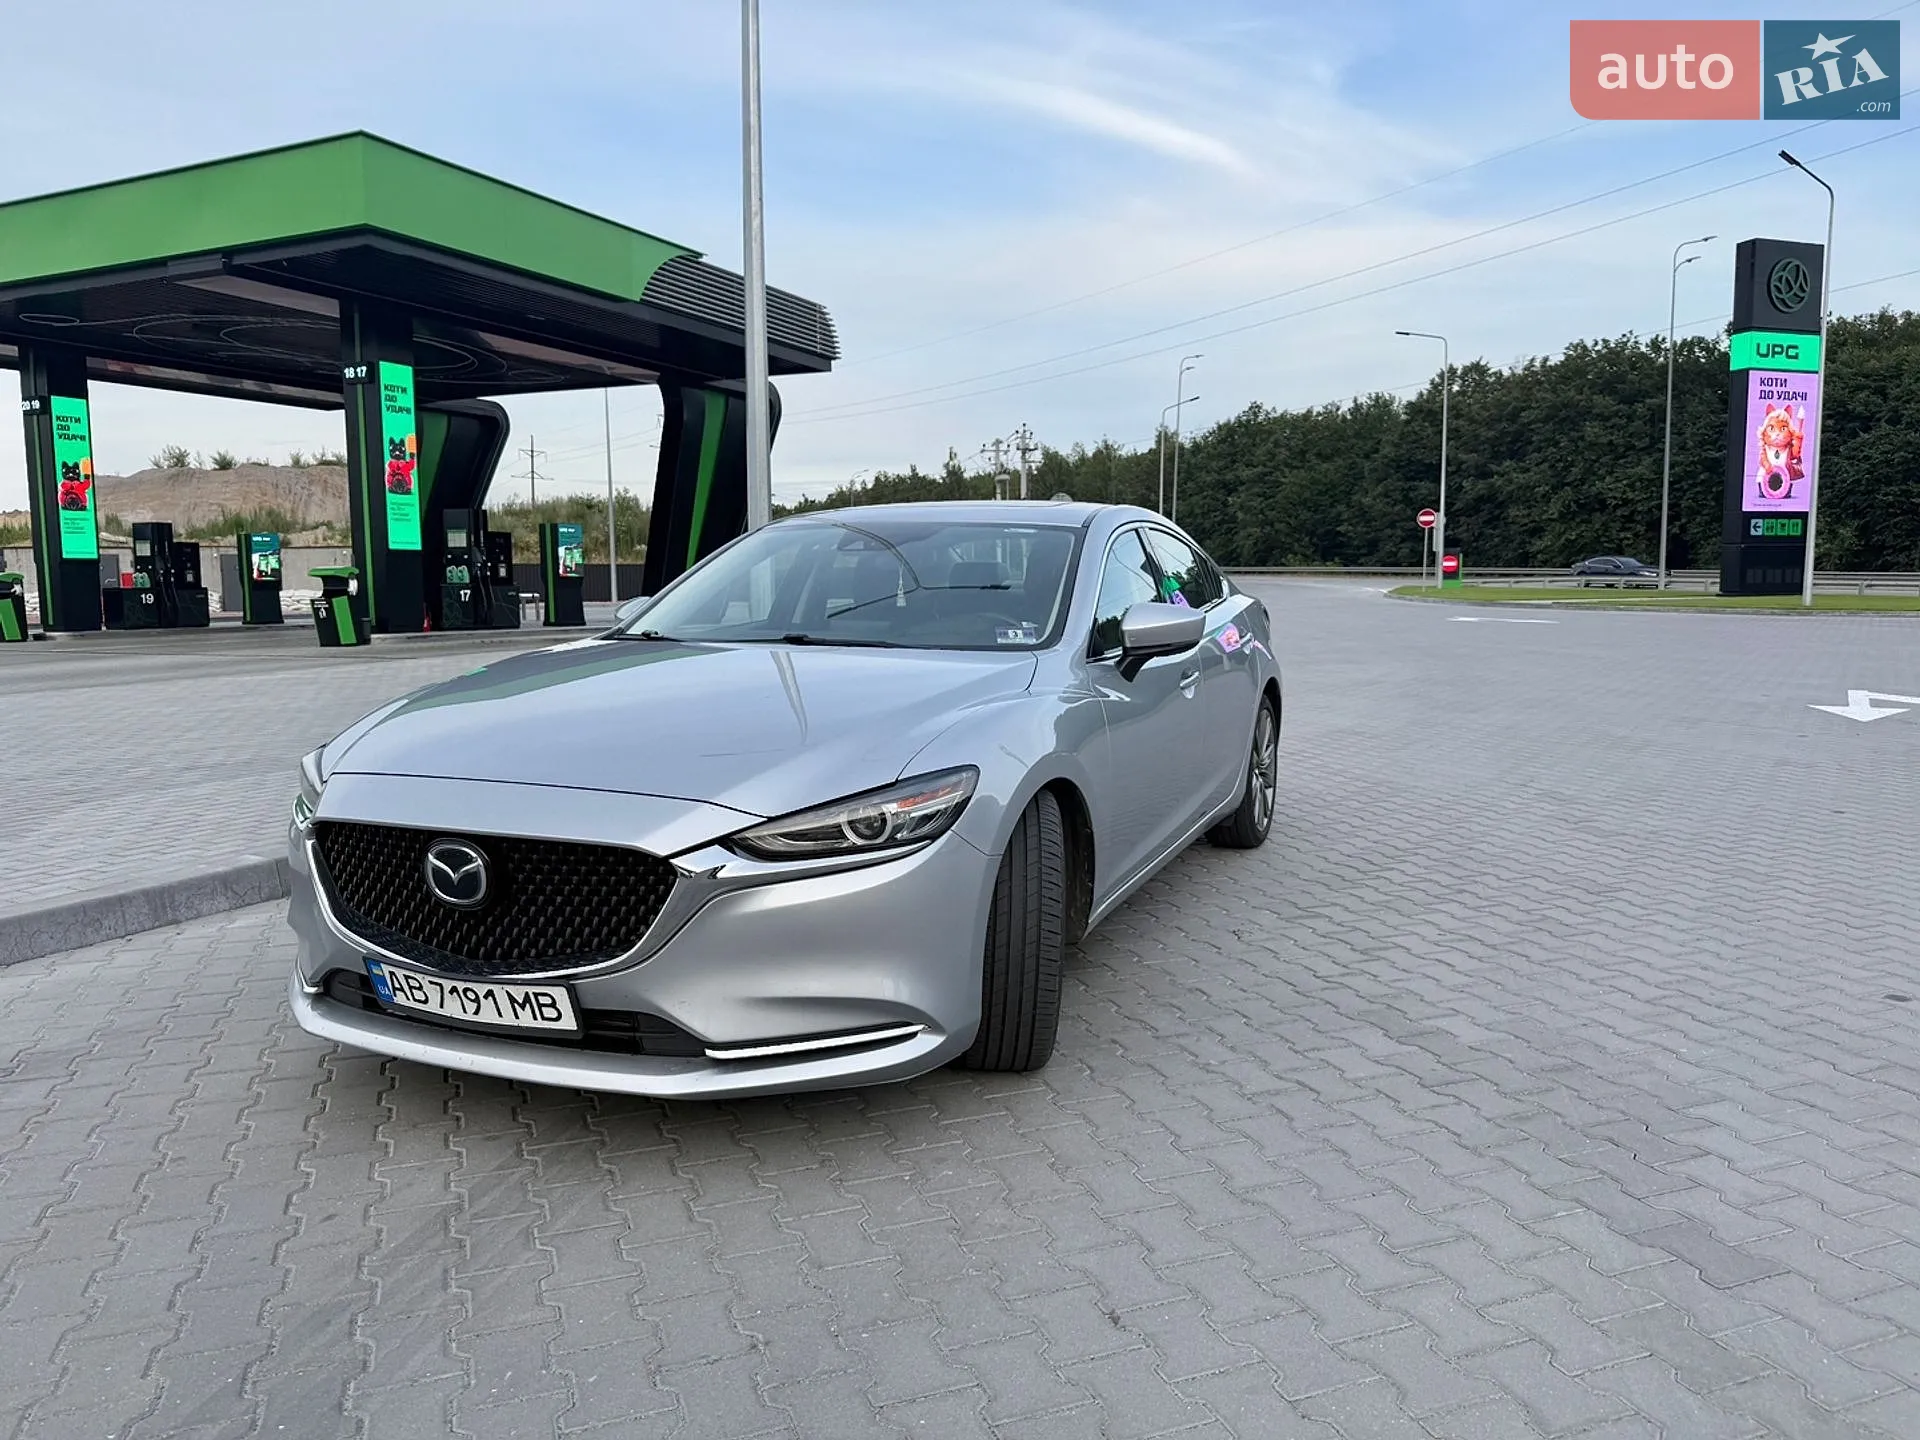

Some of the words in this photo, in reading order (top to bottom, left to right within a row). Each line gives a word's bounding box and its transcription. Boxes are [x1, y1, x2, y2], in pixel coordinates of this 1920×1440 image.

[1756, 343, 1799, 359] UPG
[344, 367, 354, 378] 18
[356, 366, 366, 377] 17
[1759, 377, 1787, 388] КОТИ
[1759, 390, 1774, 400] ДО
[1776, 391, 1807, 401] УДАЧІ
[56, 415, 81, 424] КОТИ
[140, 593, 155, 604] 19
[459, 590, 471, 601] 17
